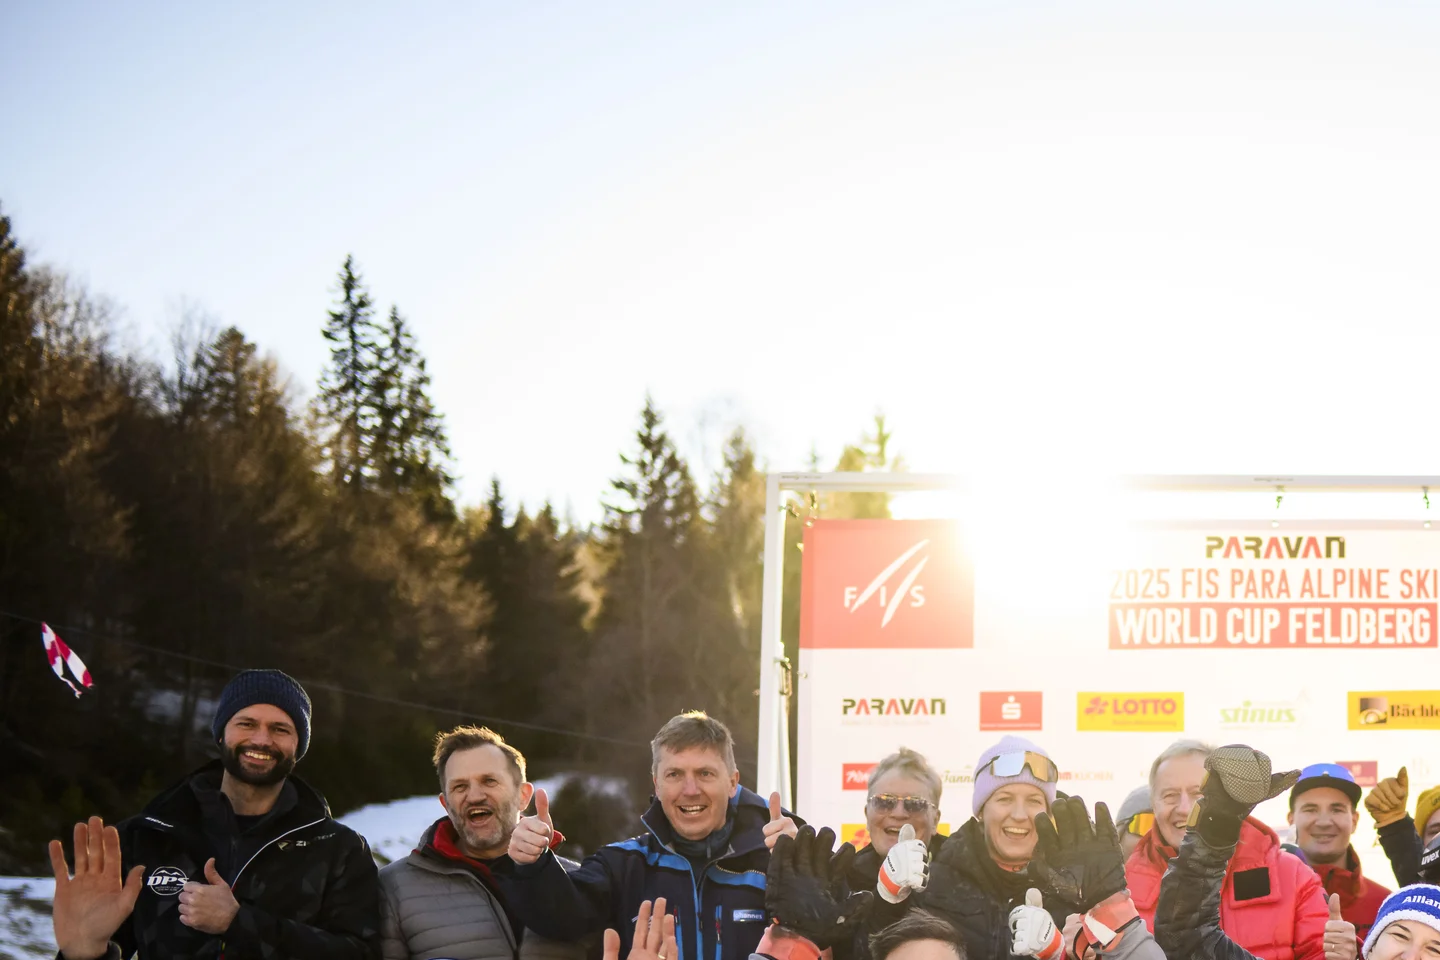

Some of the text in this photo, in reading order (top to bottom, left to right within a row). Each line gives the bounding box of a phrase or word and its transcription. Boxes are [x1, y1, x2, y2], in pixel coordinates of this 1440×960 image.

[1206, 536, 1346, 559] PARAVAN
[1109, 568, 1439, 599] 2025 FIS PARA ALPINE SKI
[1115, 607, 1431, 645] WORLD CUP FELDBERG
[842, 698, 946, 716] PARAVAN
[1112, 698, 1177, 716] LOTTO
[1219, 700, 1297, 724] stinus
[1421, 849, 1440, 866] uvex
